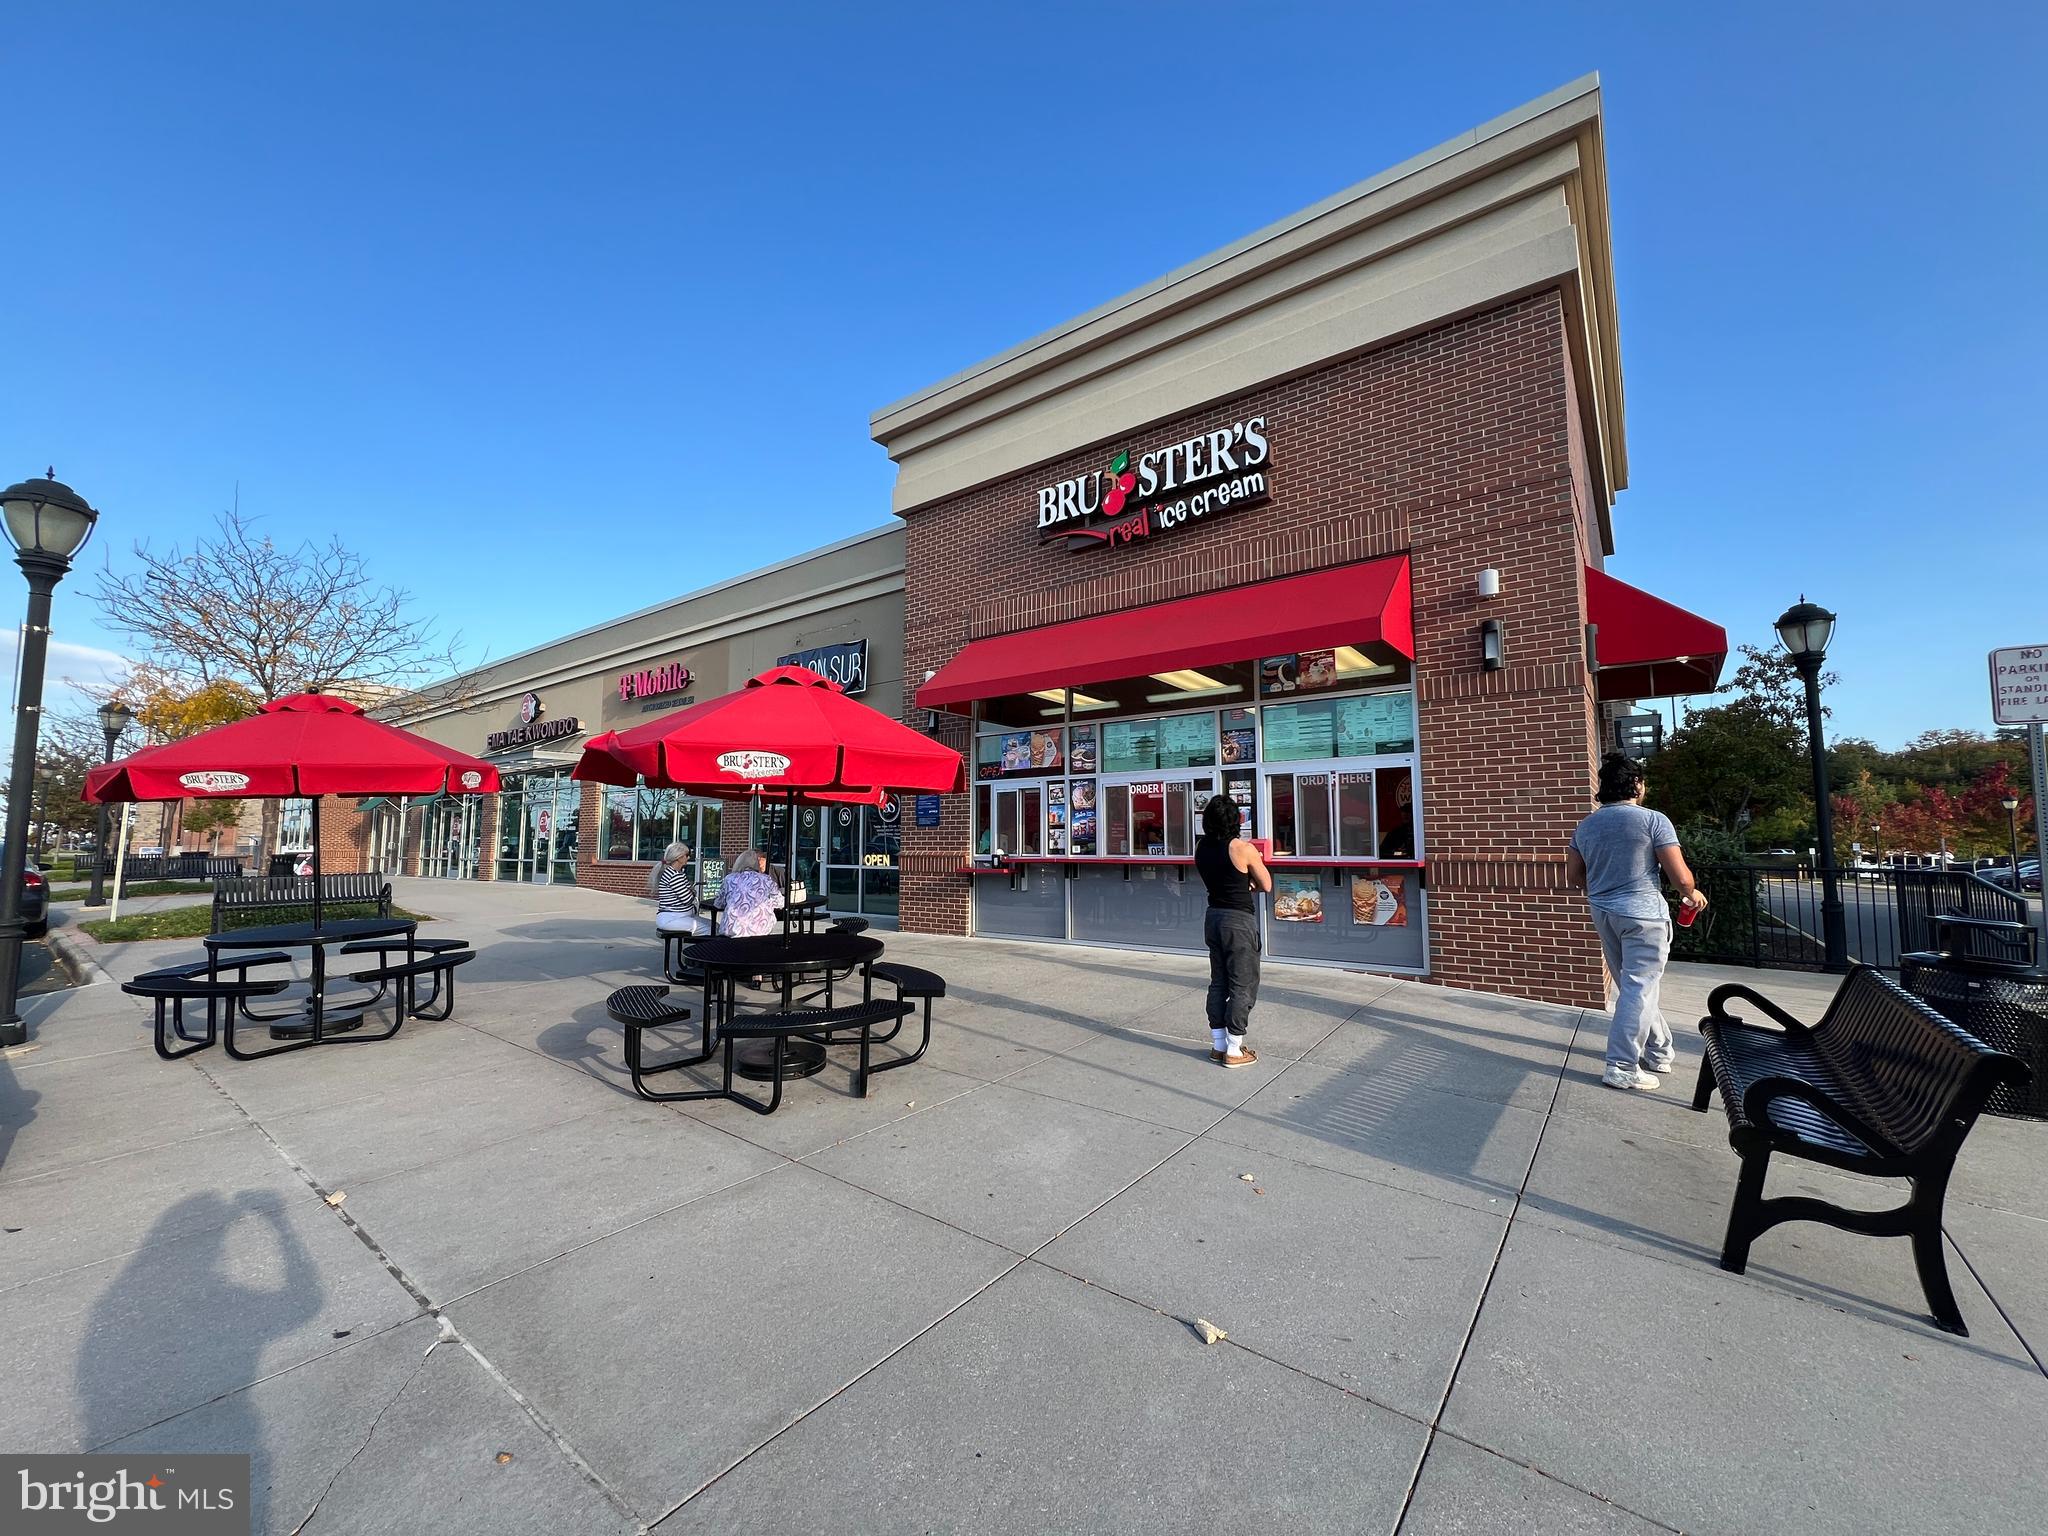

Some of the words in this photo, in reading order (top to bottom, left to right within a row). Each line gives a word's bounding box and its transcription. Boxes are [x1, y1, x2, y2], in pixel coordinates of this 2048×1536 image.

[1036, 415, 1269, 529] BRUSTER'S
[1108, 507, 1150, 547] real
[1156, 498, 1188, 529] ice
[1190, 472, 1265, 517] cream
[2020, 648, 2042, 659] NO
[618, 662, 689, 701] T-Mobile
[2000, 696, 2028, 706] FIRE
[487, 731, 505, 750] EMA
[507, 727, 524, 745] TAE
[524, 720, 555, 741] KWON
[557, 716, 575, 736] DO
[723, 754, 785, 769] BRUSTER'S
[184, 774, 245, 785] BRUSTER'S
[1341, 773, 1371, 784] HERE
[1130, 783, 1160, 794] ORDER
[864, 854, 890, 867] OPEN
